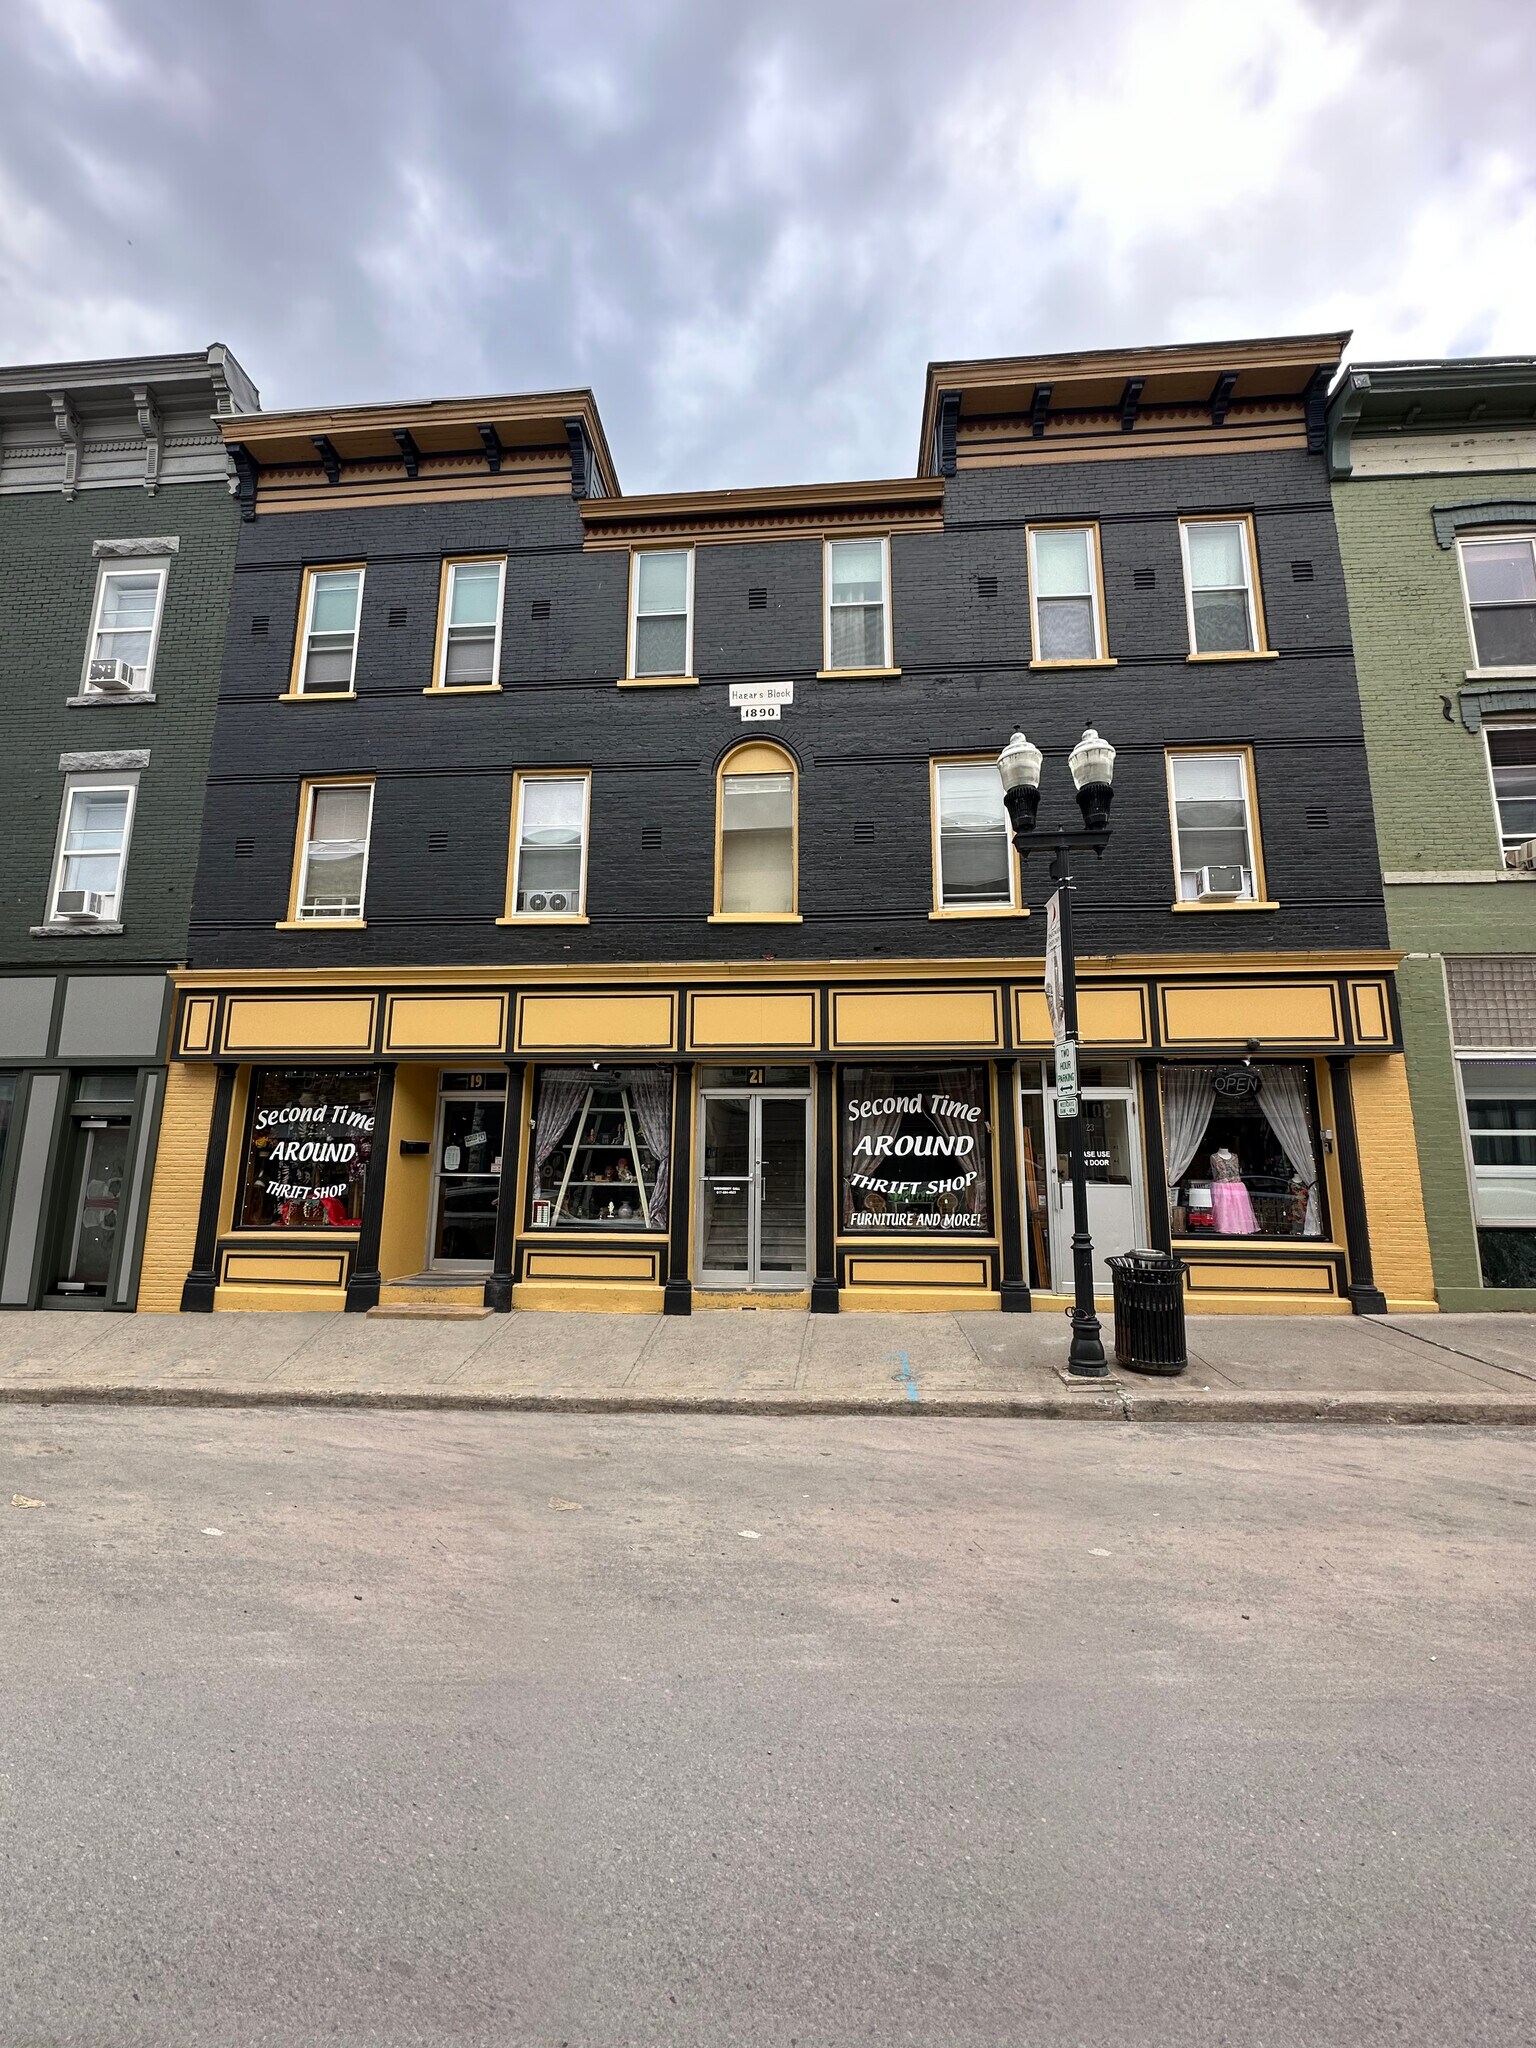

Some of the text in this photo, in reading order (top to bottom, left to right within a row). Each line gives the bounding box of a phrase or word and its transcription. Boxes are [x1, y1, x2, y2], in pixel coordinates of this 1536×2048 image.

[767, 688, 791, 698] Block
[1060, 1048, 1070, 1058] TWO
[1059, 1060, 1072, 1070] HOUR
[470, 1074, 483, 1088] 19
[750, 1069, 763, 1084] 21
[1057, 1072, 1075, 1083] PARKING
[1215, 1078, 1257, 1091] OPEN
[848, 1093, 982, 1123] Second Time
[255, 1104, 376, 1131] Second Time
[1086, 1123, 1095, 1132] 23
[269, 1141, 356, 1163] AROUND
[852, 1135, 974, 1157] AROUND
[1096, 1150, 1111, 1158] USE
[850, 1171, 978, 1195] THRIFT SHOP
[266, 1181, 348, 1200] THRIFT SHOP
[850, 1212, 982, 1227] FURNITURE AND MORE!
